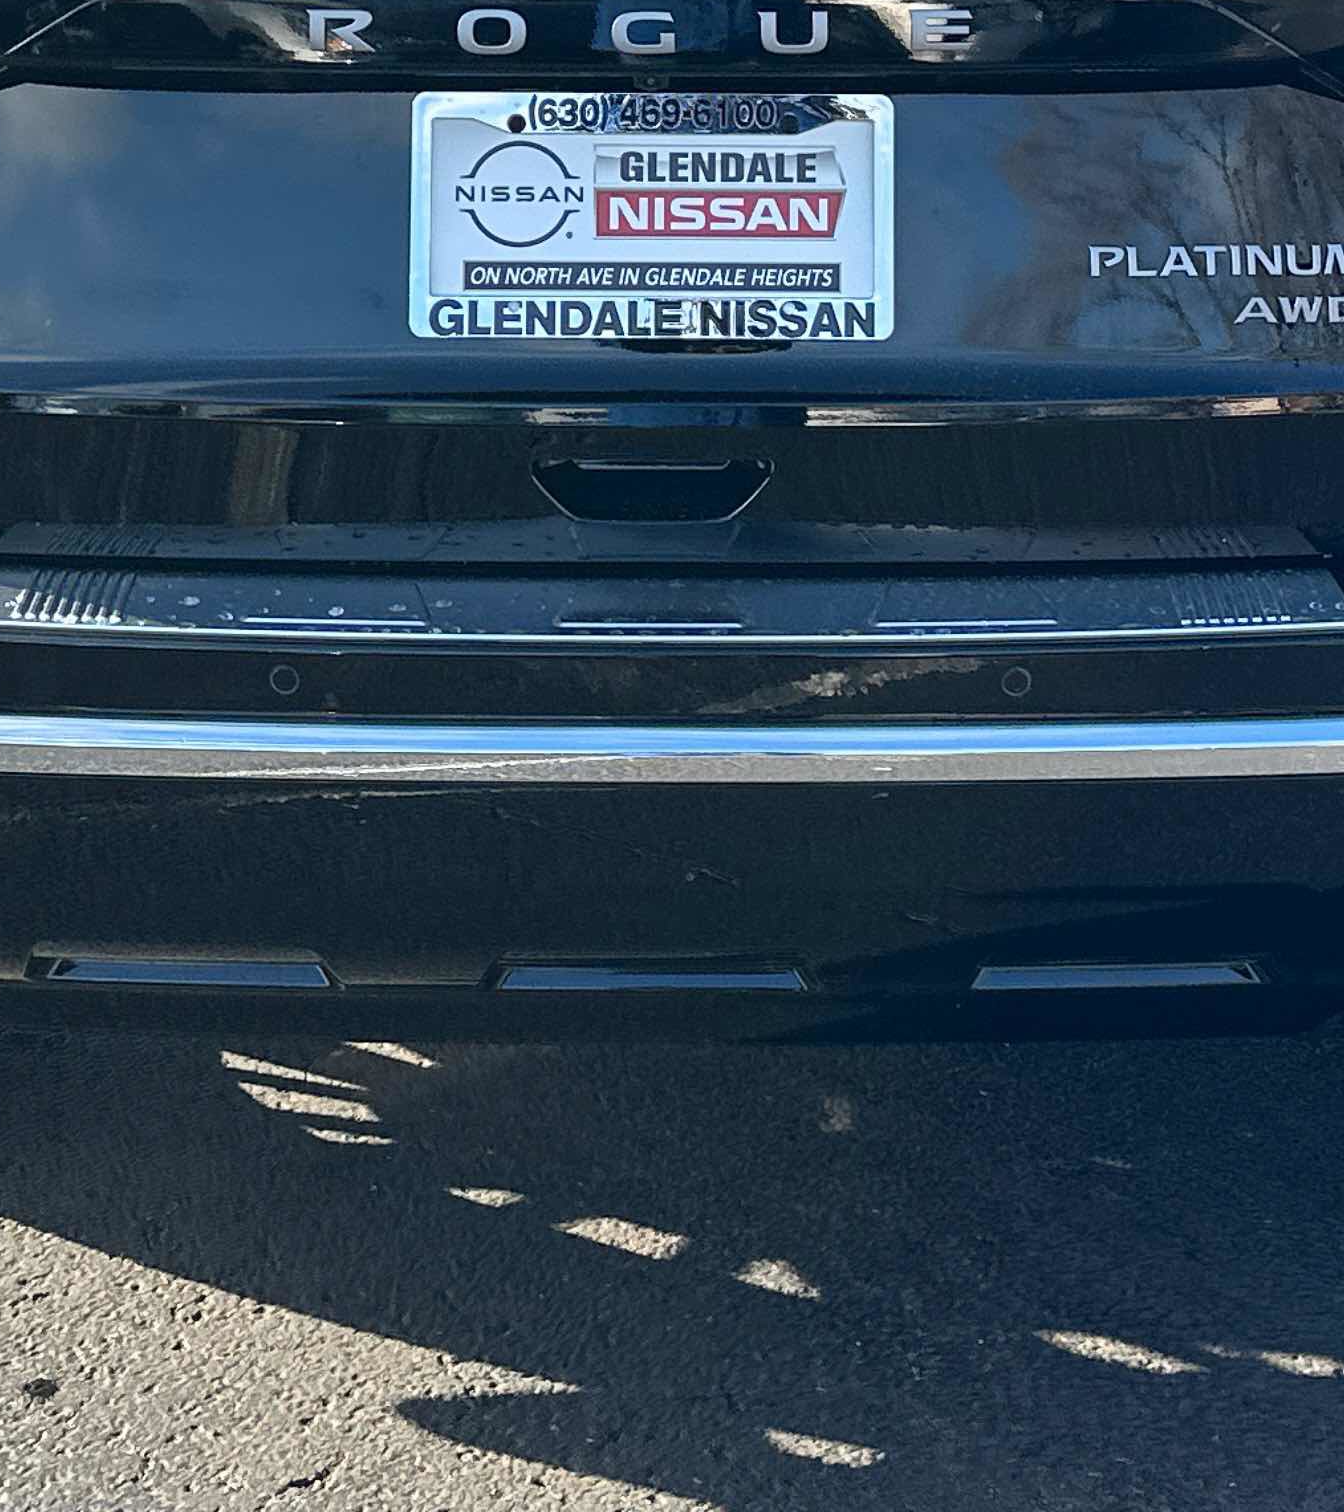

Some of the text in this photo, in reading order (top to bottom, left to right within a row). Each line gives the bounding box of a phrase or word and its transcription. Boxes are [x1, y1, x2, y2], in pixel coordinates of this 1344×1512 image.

[304, 7, 975, 56] ROGUE
[528, 94, 778, 132] (630) 469-6100
[619, 150, 818, 185] GLENDALE
[455, 184, 585, 204] NISSAN
[608, 196, 830, 233] NISSAN
[470, 266, 834, 287] ON NORTH AVE IN GLENDALE HEIGHTS
[429, 299, 876, 337] GLENDALE NISSAN
